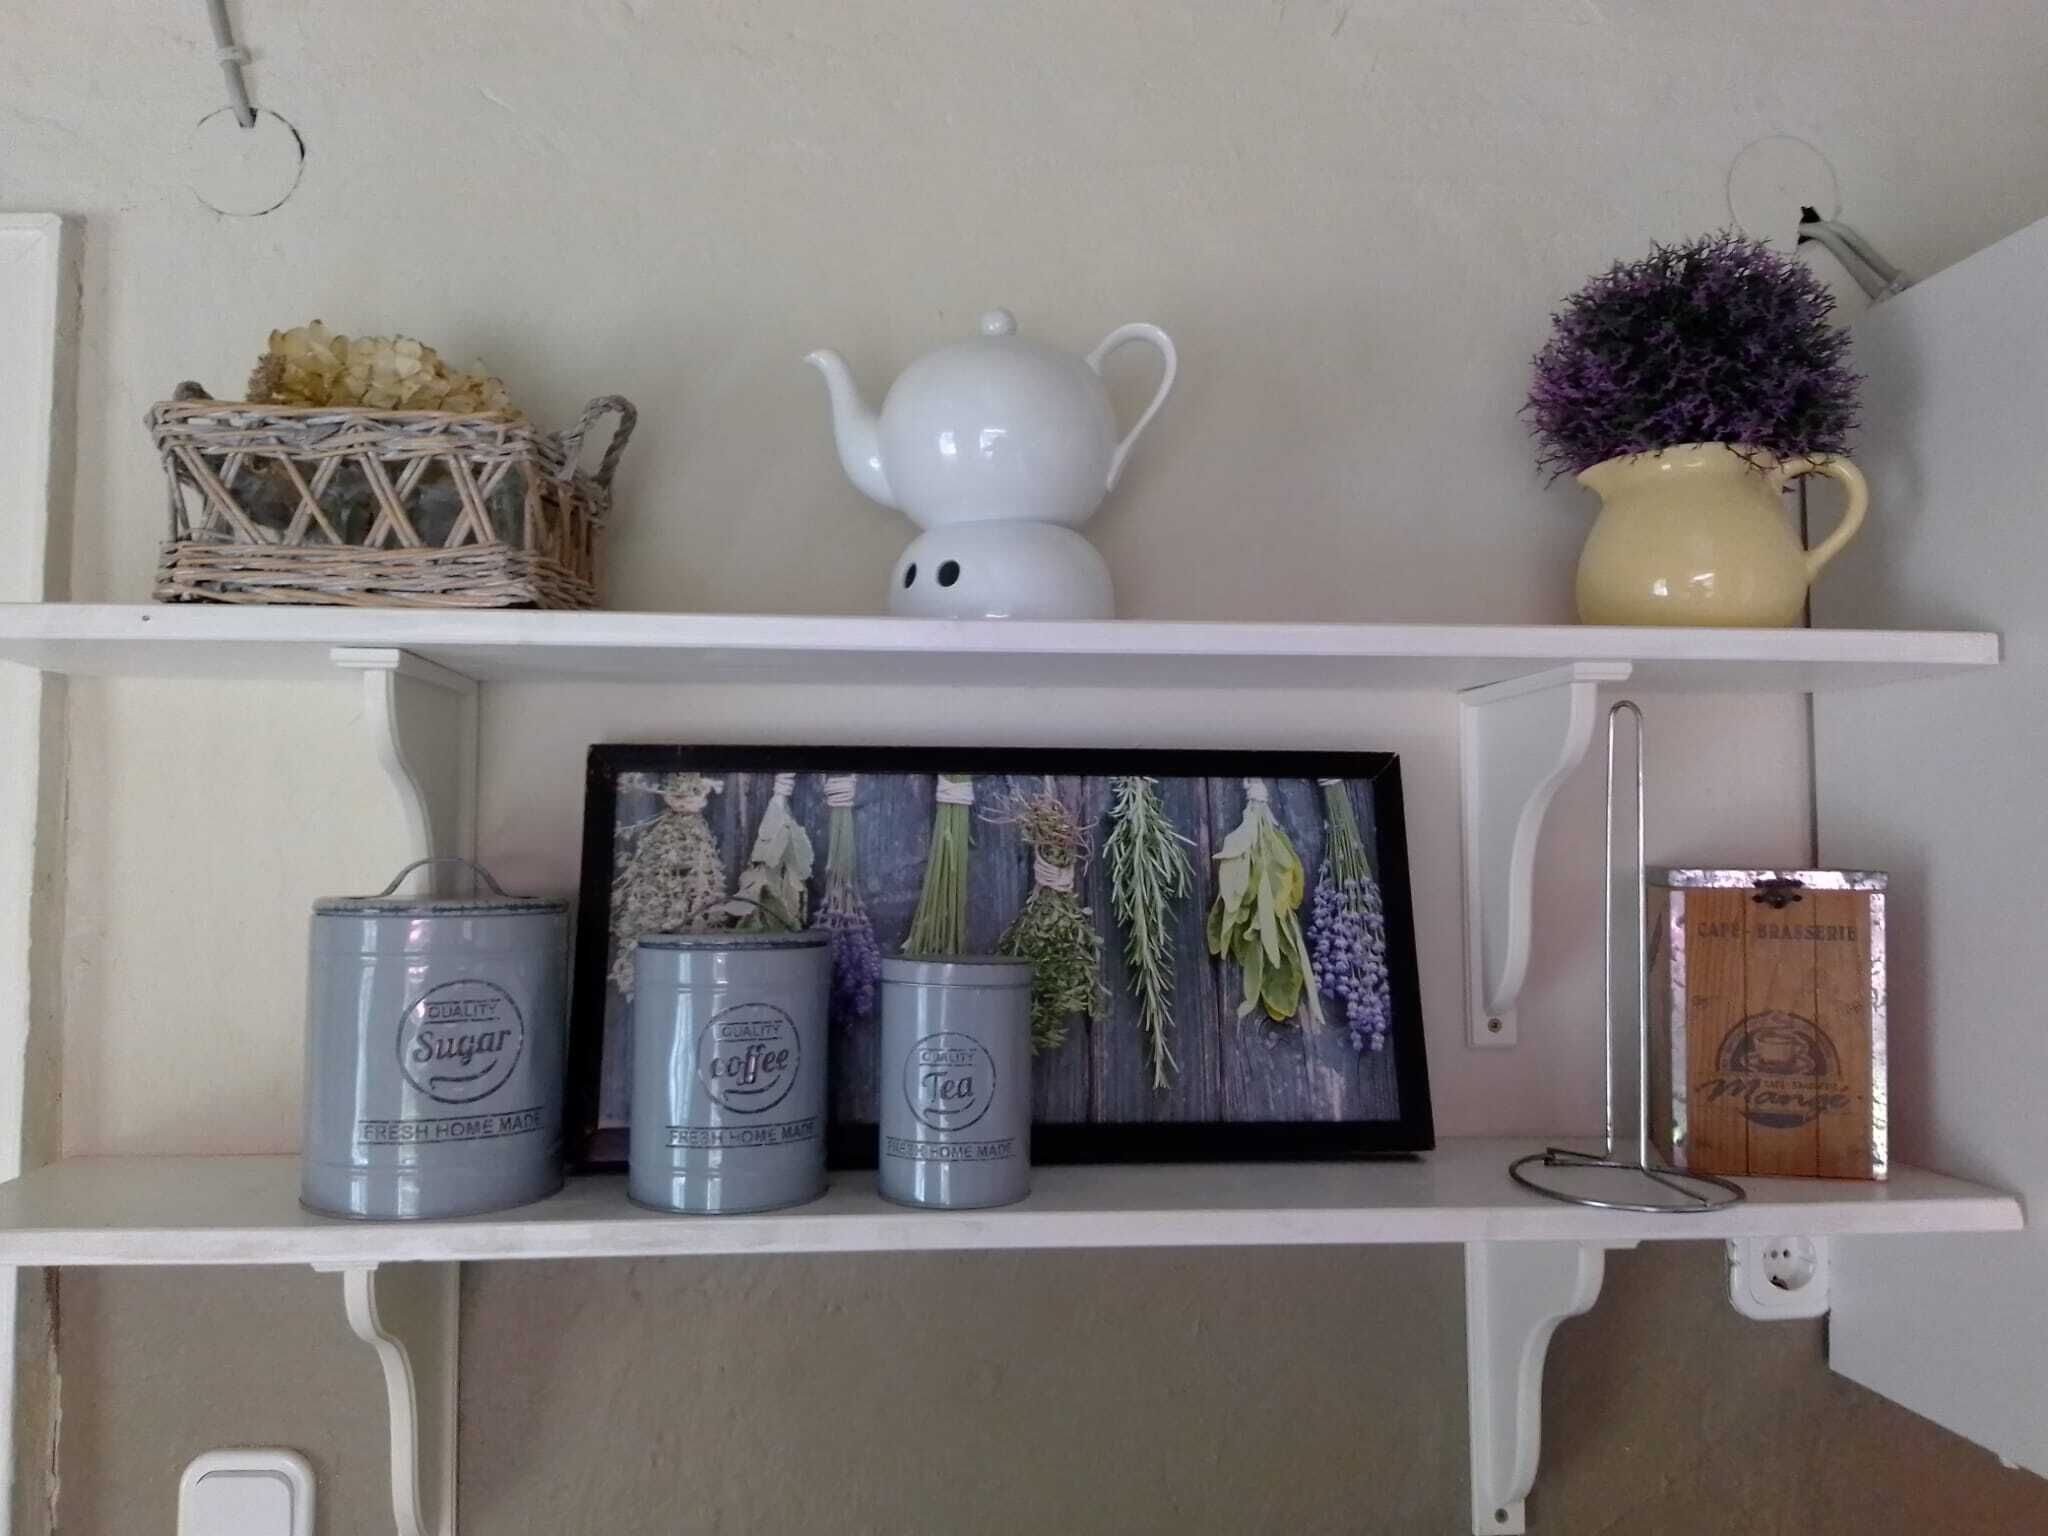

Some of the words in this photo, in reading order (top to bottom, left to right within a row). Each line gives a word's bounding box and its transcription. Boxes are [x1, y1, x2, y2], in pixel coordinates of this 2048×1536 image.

[428, 1003, 498, 1019] QUALITY
[721, 1023, 781, 1038] QUALITY
[412, 1029, 512, 1066] Sugar
[921, 1051, 975, 1065] QUALITY
[922, 1071, 975, 1100] Tea
[364, 1121, 428, 1141] FRESH
[435, 1117, 496, 1137] HOME
[499, 1112, 542, 1131] MADE
[670, 1129, 723, 1145] FRESH
[729, 1127, 776, 1144] HOME
[780, 1121, 815, 1138] MADE
[887, 1140, 926, 1157] FRESH
[930, 1143, 973, 1159] HOME
[977, 1142, 1013, 1158] MADE
